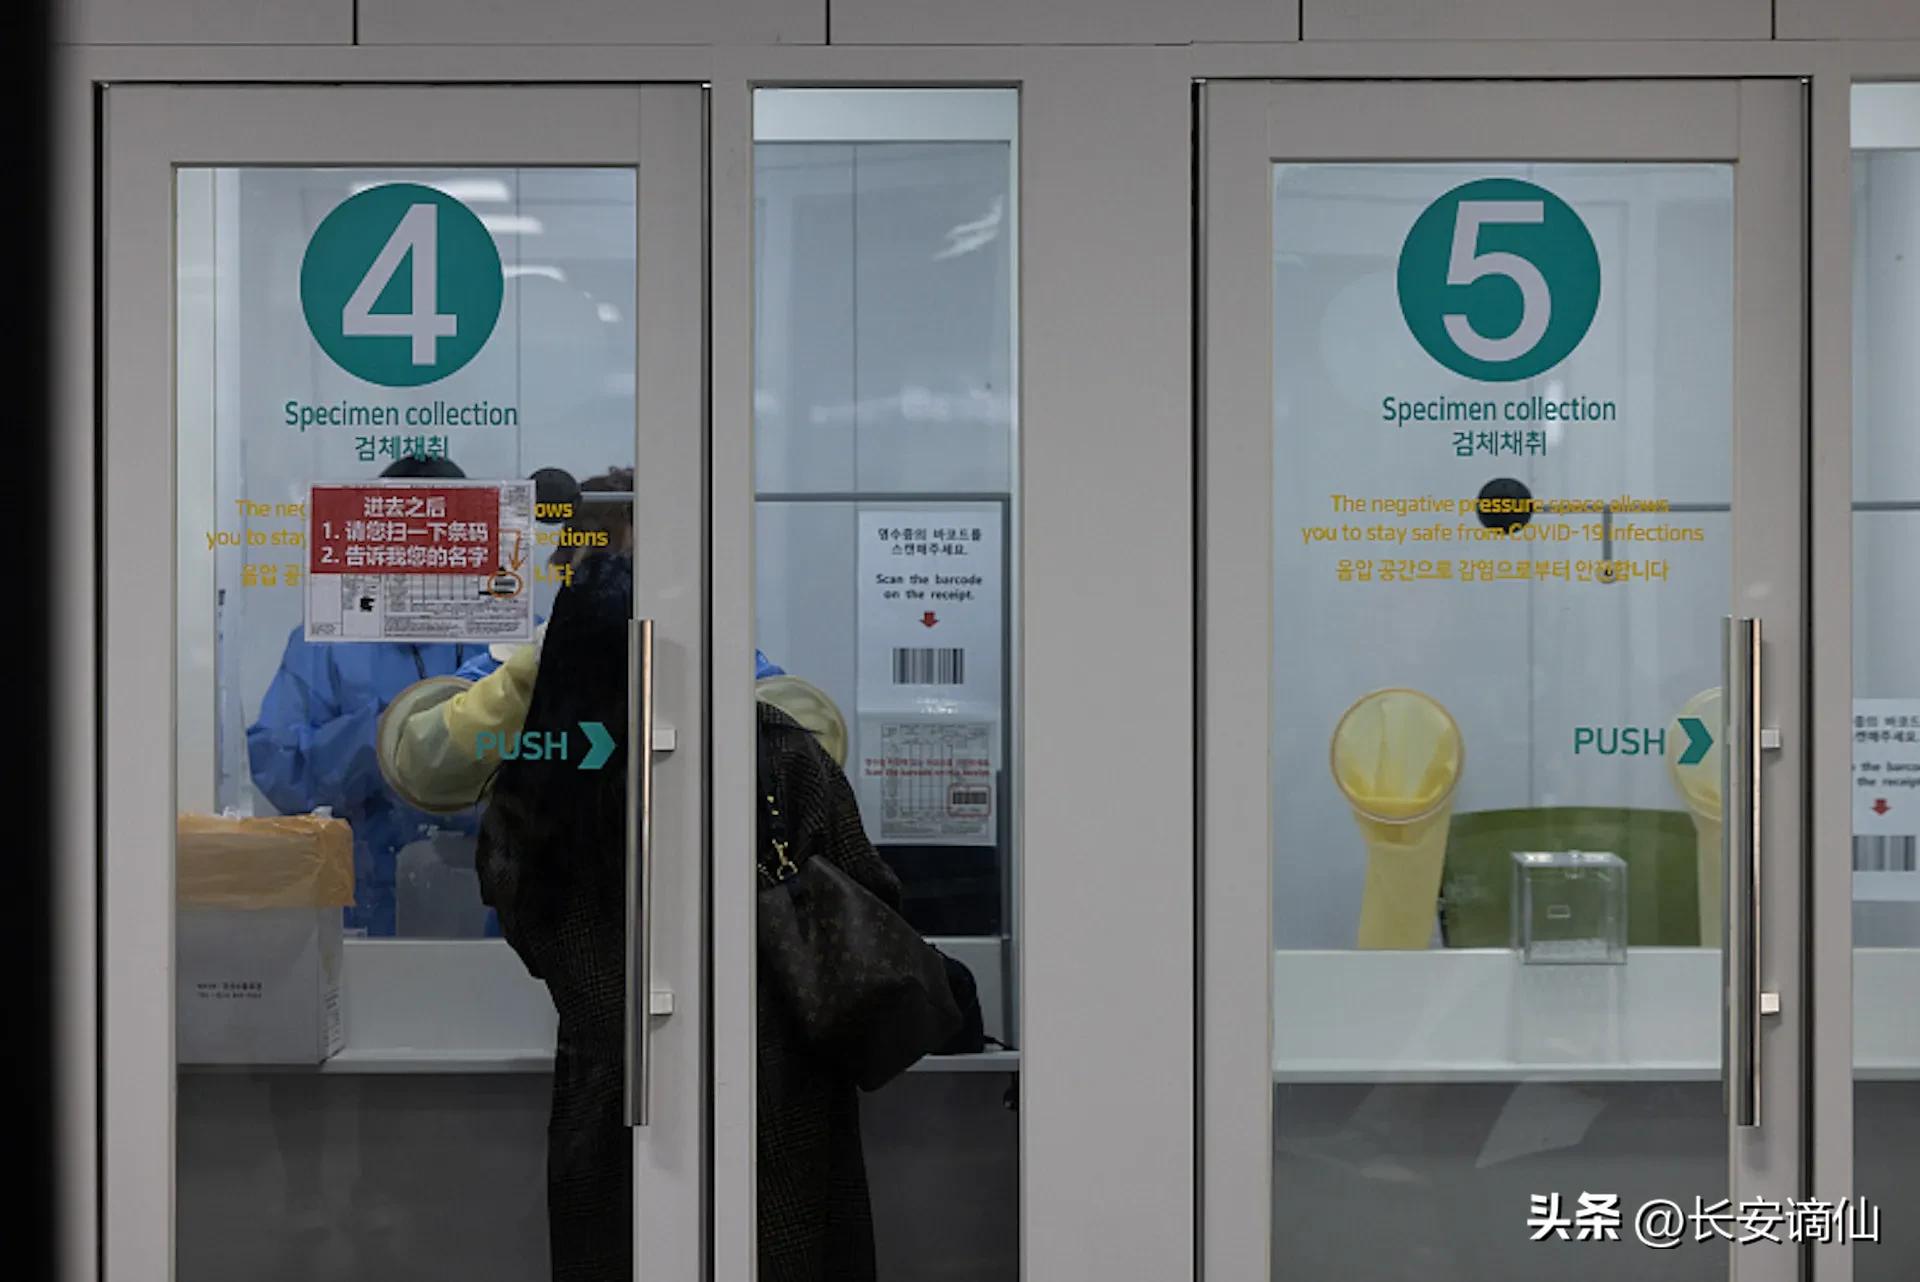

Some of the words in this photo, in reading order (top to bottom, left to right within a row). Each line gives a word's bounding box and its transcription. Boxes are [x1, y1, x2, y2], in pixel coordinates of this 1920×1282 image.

[342, 203, 457, 366] 4
[1442, 200, 1552, 363] 5
[285, 401, 399, 431] Specimen
[405, 401, 518, 426] collection
[1382, 396, 1497, 427] Specimen
[1503, 396, 1617, 422] collection
[355, 436, 449, 462] 검체채취
[1452, 431, 1547, 456] 검체채취
[235, 499, 272, 517] The
[364, 496, 446, 517] 进去之后
[1330, 494, 1366, 513] The
[1371, 496, 1454, 517] negative
[1459, 499, 1544, 516] pressure
[1551, 499, 1604, 516] space
[1610, 495, 1670, 513] allows
[206, 530, 241, 551] you
[247, 528, 267, 545] to
[322, 522, 340, 540] 1.
[345, 522, 489, 542] 请您扫一下条码
[1302, 527, 1337, 544] you
[1342, 524, 1361, 541] to
[1367, 524, 1408, 544] stay
[1412, 524, 1453, 541] safe
[1457, 523, 1505, 541] from
[1509, 524, 1604, 542] COVID-19
[1607, 523, 1705, 542] infections
[320, 547, 340, 564] 2.
[345, 546, 489, 568] 告诉我您的名字
[241, 563, 277, 588] 음압
[876, 573, 903, 585] Scan
[909, 573, 929, 585] the
[935, 573, 982, 585] barcode
[1336, 559, 1373, 582] 음압
[1378, 559, 1453, 582] 공간으로
[1459, 559, 1571, 582] 감염으로부터
[883, 591, 900, 600] on
[906, 590, 925, 600] the
[476, 731, 568, 760] PUSH
[1574, 727, 1665, 755] PUSH
